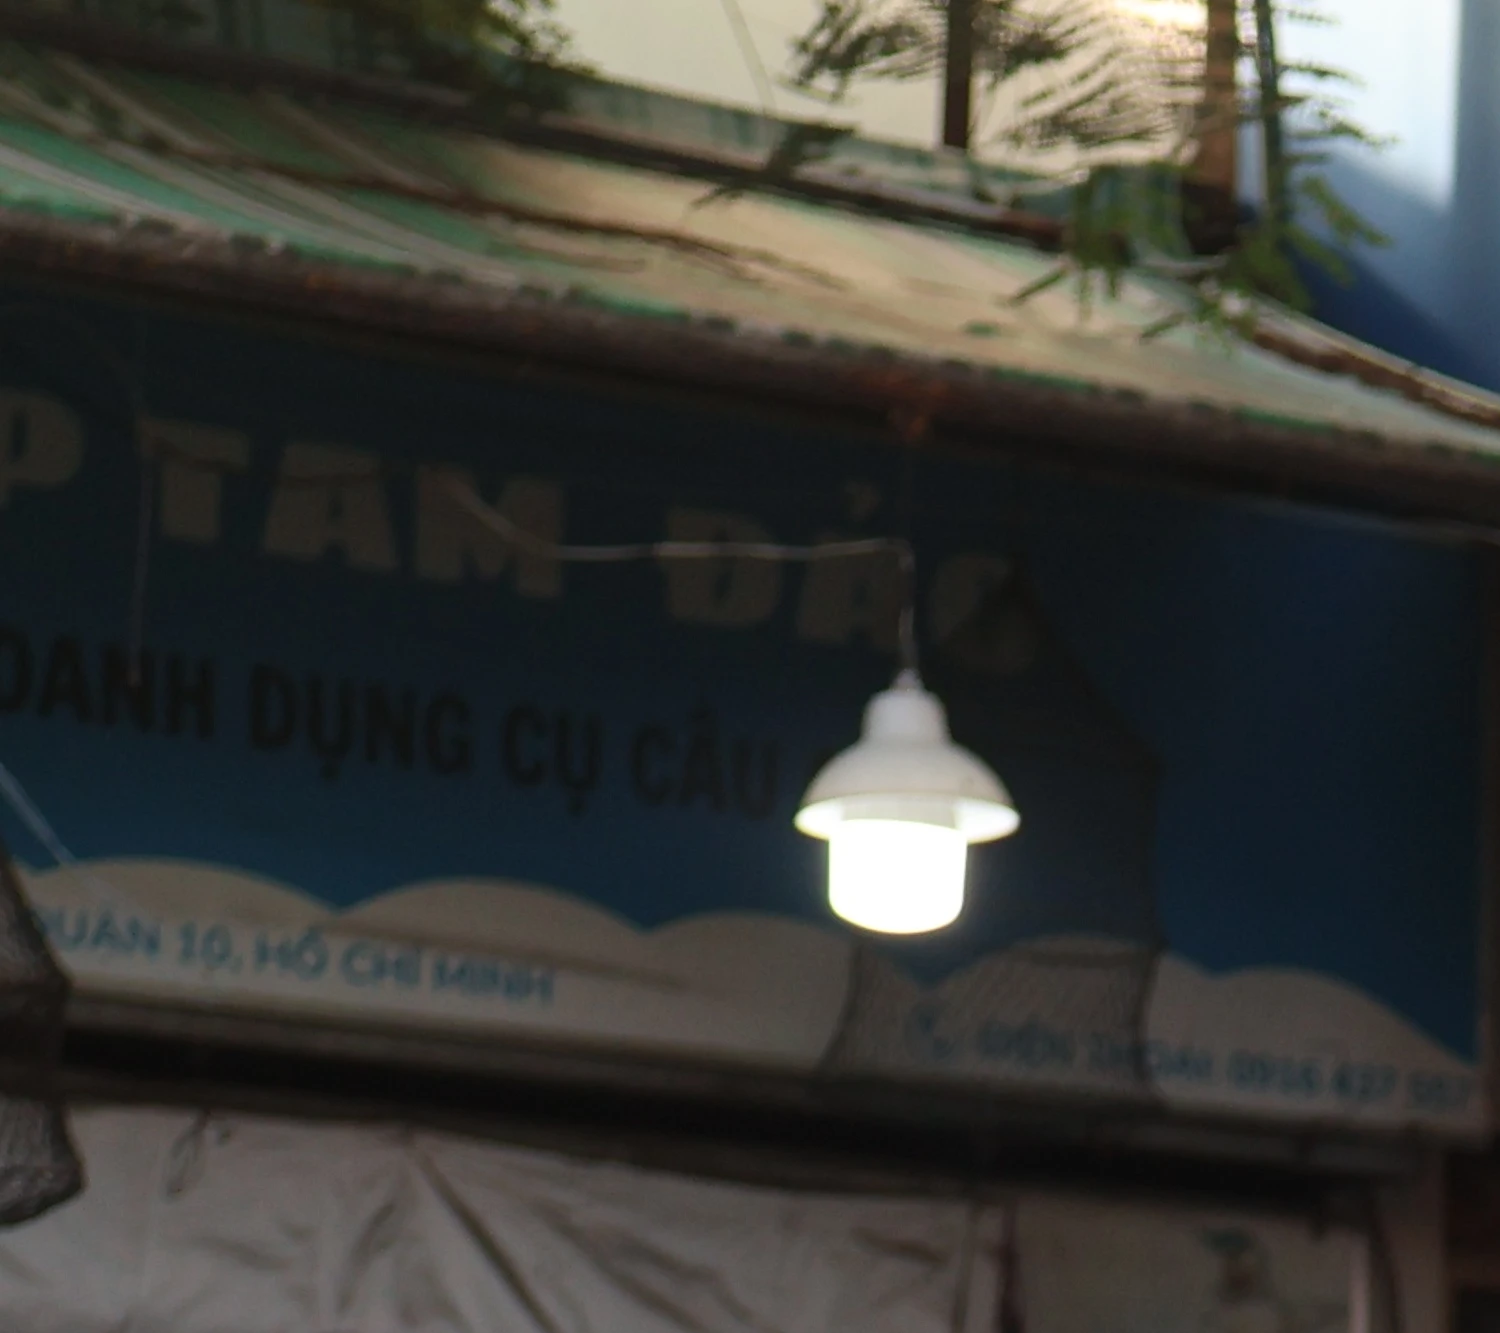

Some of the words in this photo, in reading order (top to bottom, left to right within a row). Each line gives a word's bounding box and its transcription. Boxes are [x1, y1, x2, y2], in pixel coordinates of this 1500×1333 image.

[247, 660, 477, 782] DỤNG
[503, 700, 603, 818] CỤ
[430, 953, 558, 1008] MINH
